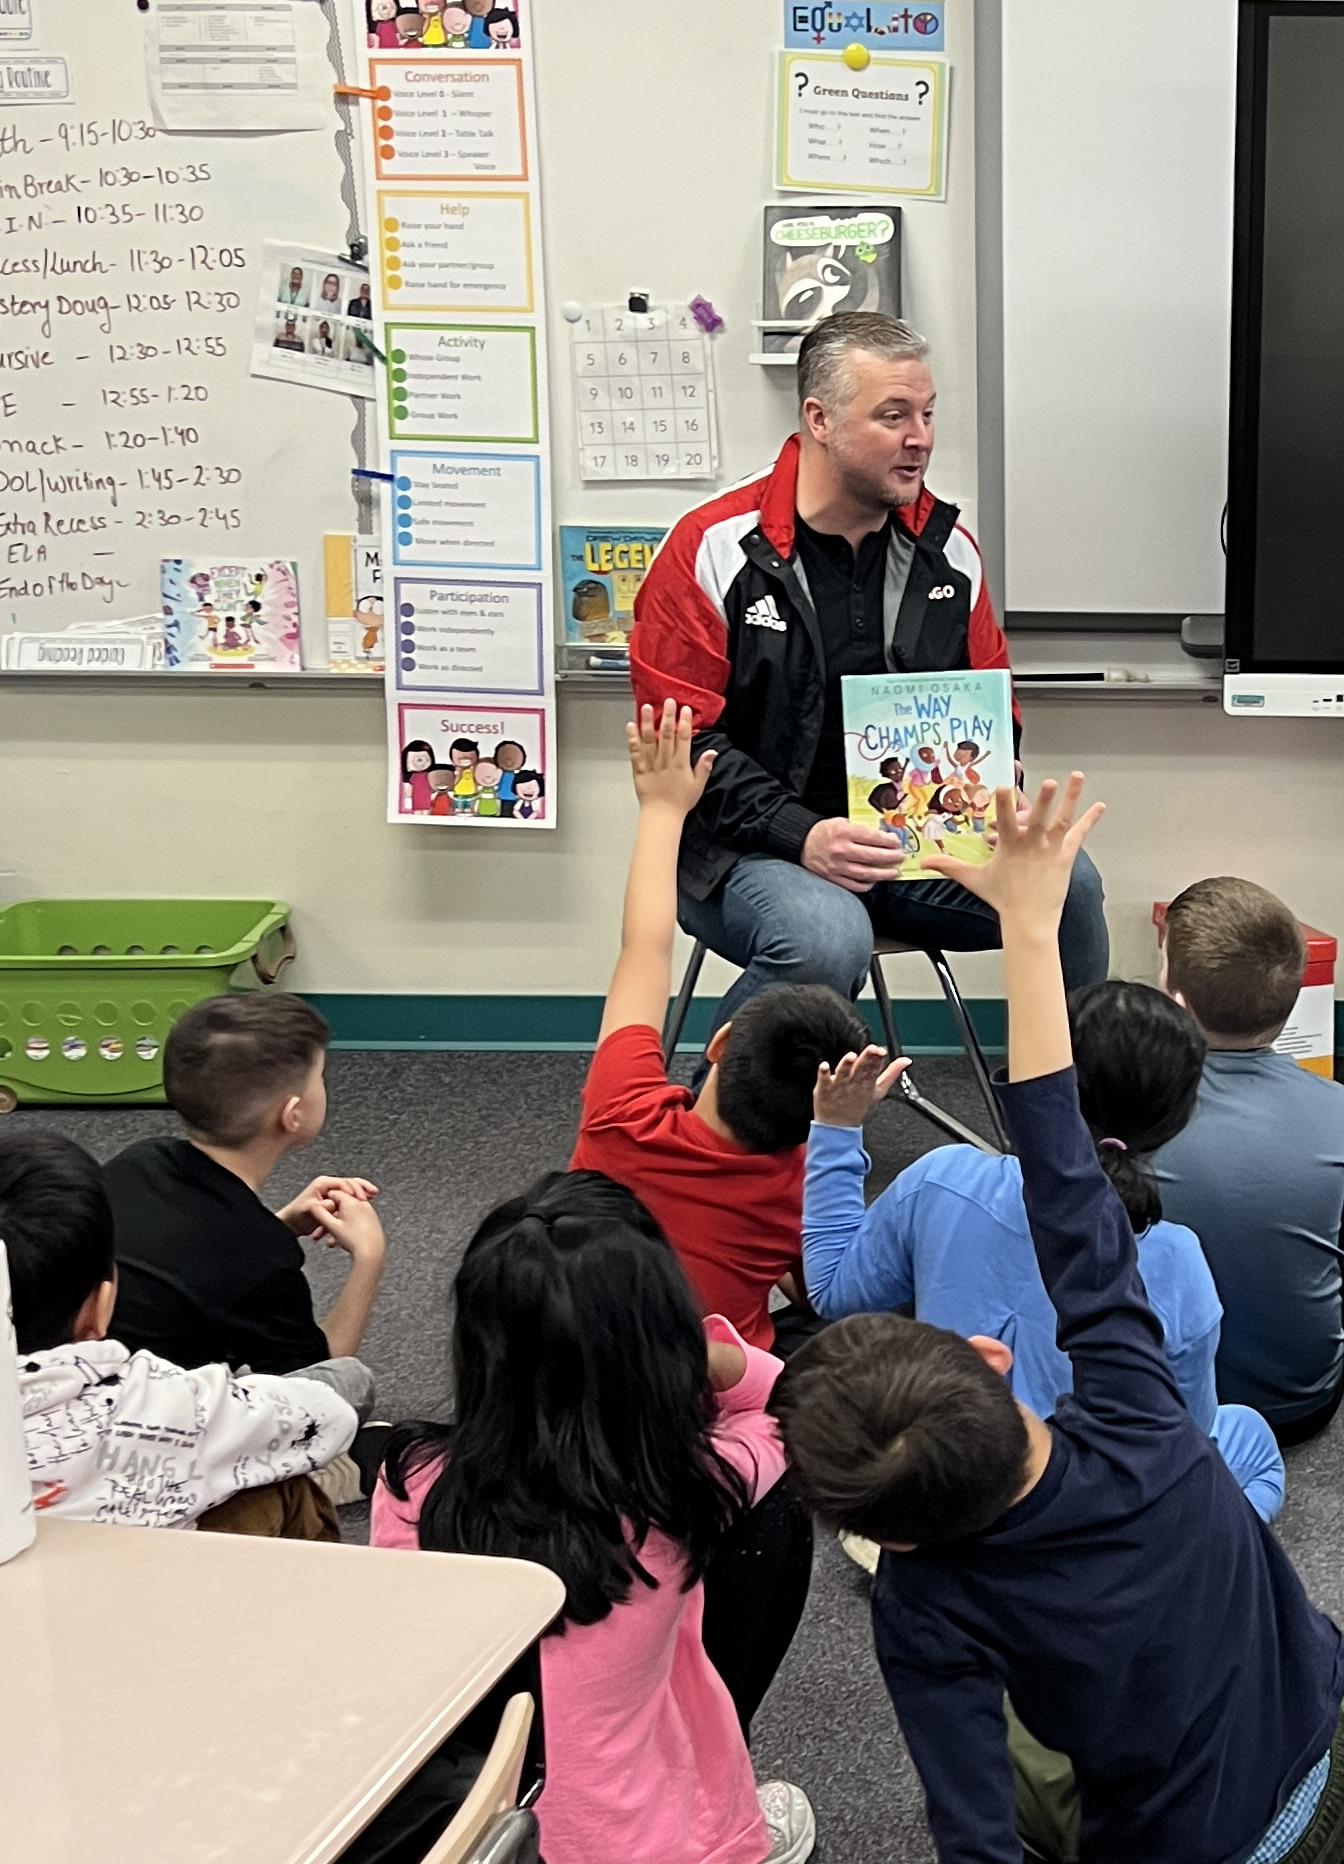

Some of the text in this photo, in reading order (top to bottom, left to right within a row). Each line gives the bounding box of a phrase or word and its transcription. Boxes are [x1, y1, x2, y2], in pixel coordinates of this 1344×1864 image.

[6, 66, 52, 88] Routine
[405, 70, 489, 83] Conversation
[813, 85, 849, 98] Green
[852, 87, 909, 101] Questions
[440, 203, 470, 217] Help
[775, 219, 890, 241] CHEESEBURGER?
[585, 316, 687, 331] 1 2 3 4
[438, 336, 486, 350] Activity
[586, 351, 690, 366] 5 6 7 8
[589, 385, 696, 400] 9 10 11 12
[590, 419, 699, 435] 13 14 15 16
[592, 453, 702, 468] 17 18 19 20
[432, 463, 501, 477] Movement
[7, 542, 47, 564] ELA
[430, 589, 509, 604] Participation
[871, 682, 982, 696] NAOMI OSAKA
[894, 694, 952, 719] The WAY
[440, 719, 505, 735] Success!
[864, 714, 993, 750] CHAMPS PLAY
